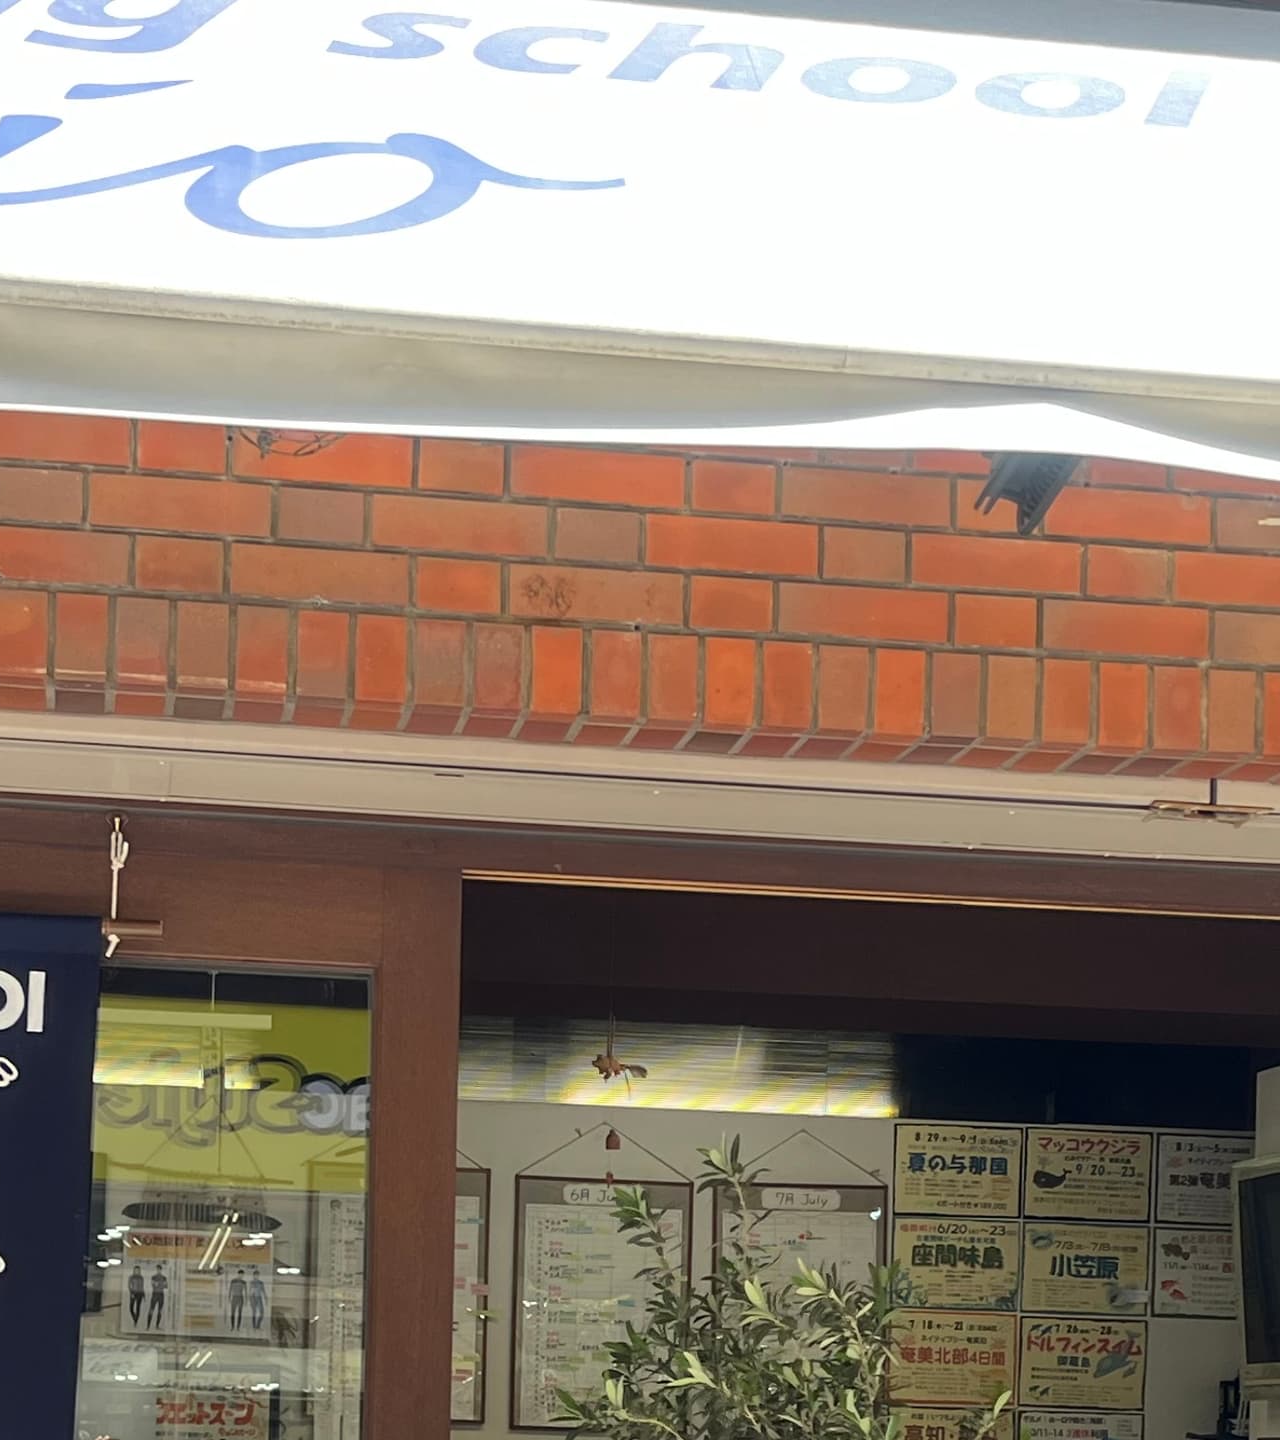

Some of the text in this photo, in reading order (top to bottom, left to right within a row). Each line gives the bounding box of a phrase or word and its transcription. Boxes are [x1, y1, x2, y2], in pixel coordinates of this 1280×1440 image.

[326, 12, 1210, 129] school
[1038, 1136, 1141, 1155] マッコウクジラ
[570, 1188, 590, 1202] 6月
[776, 1192, 828, 1208] 7月 July
[912, 1243, 1004, 1269] 座間味島
[1049, 1253, 1121, 1280] 小笠原
[1027, 1333, 1143, 1356] ドルフィンスイム
[900, 1345, 1006, 1367] 奄美北部4日間
